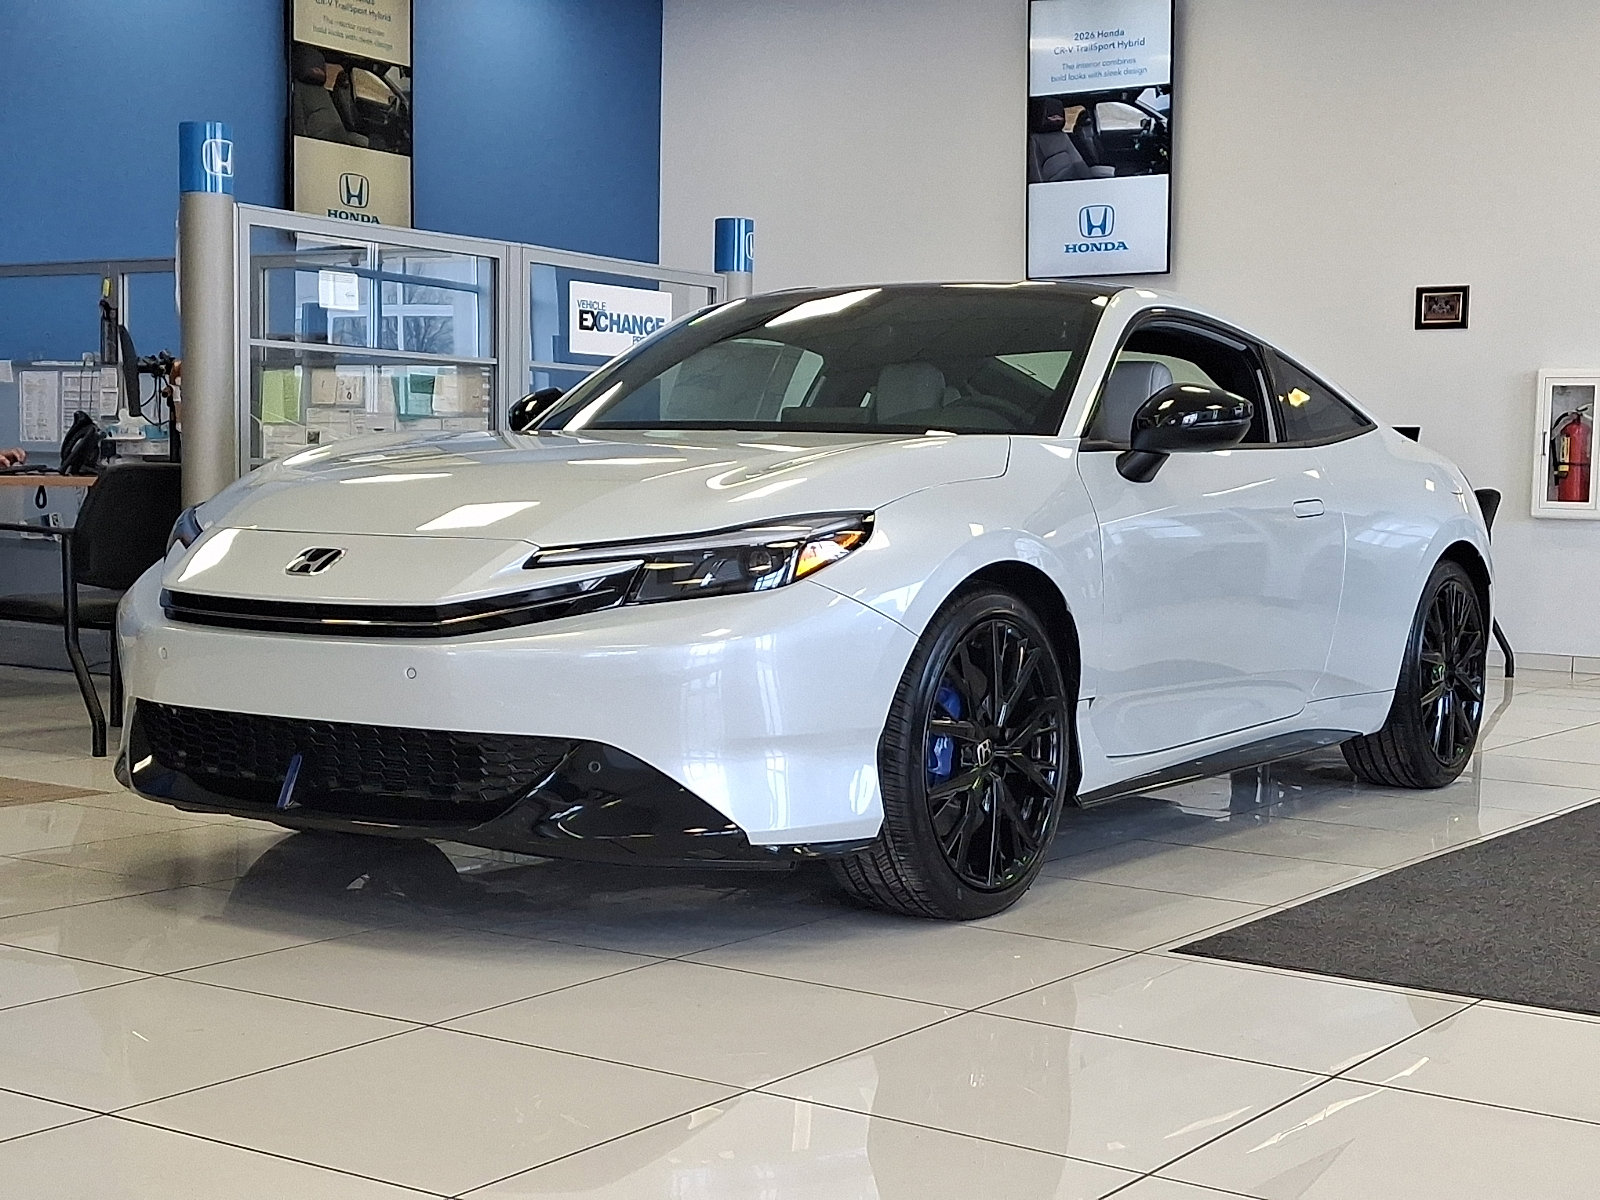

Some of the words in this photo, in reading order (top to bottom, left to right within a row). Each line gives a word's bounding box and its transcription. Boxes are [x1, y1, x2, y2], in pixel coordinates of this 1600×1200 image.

[1074, 32, 1095, 40] 2026
[1097, 28, 1124, 38] Honda
[1054, 46, 1074, 55] CR-V
[1076, 42, 1116, 52] TrailSport
[1118, 37, 1146, 49] Hybrid
[328, 209, 380, 224] HONDA
[1064, 242, 1128, 253] HONDA
[577, 300, 606, 310] VEHICLE
